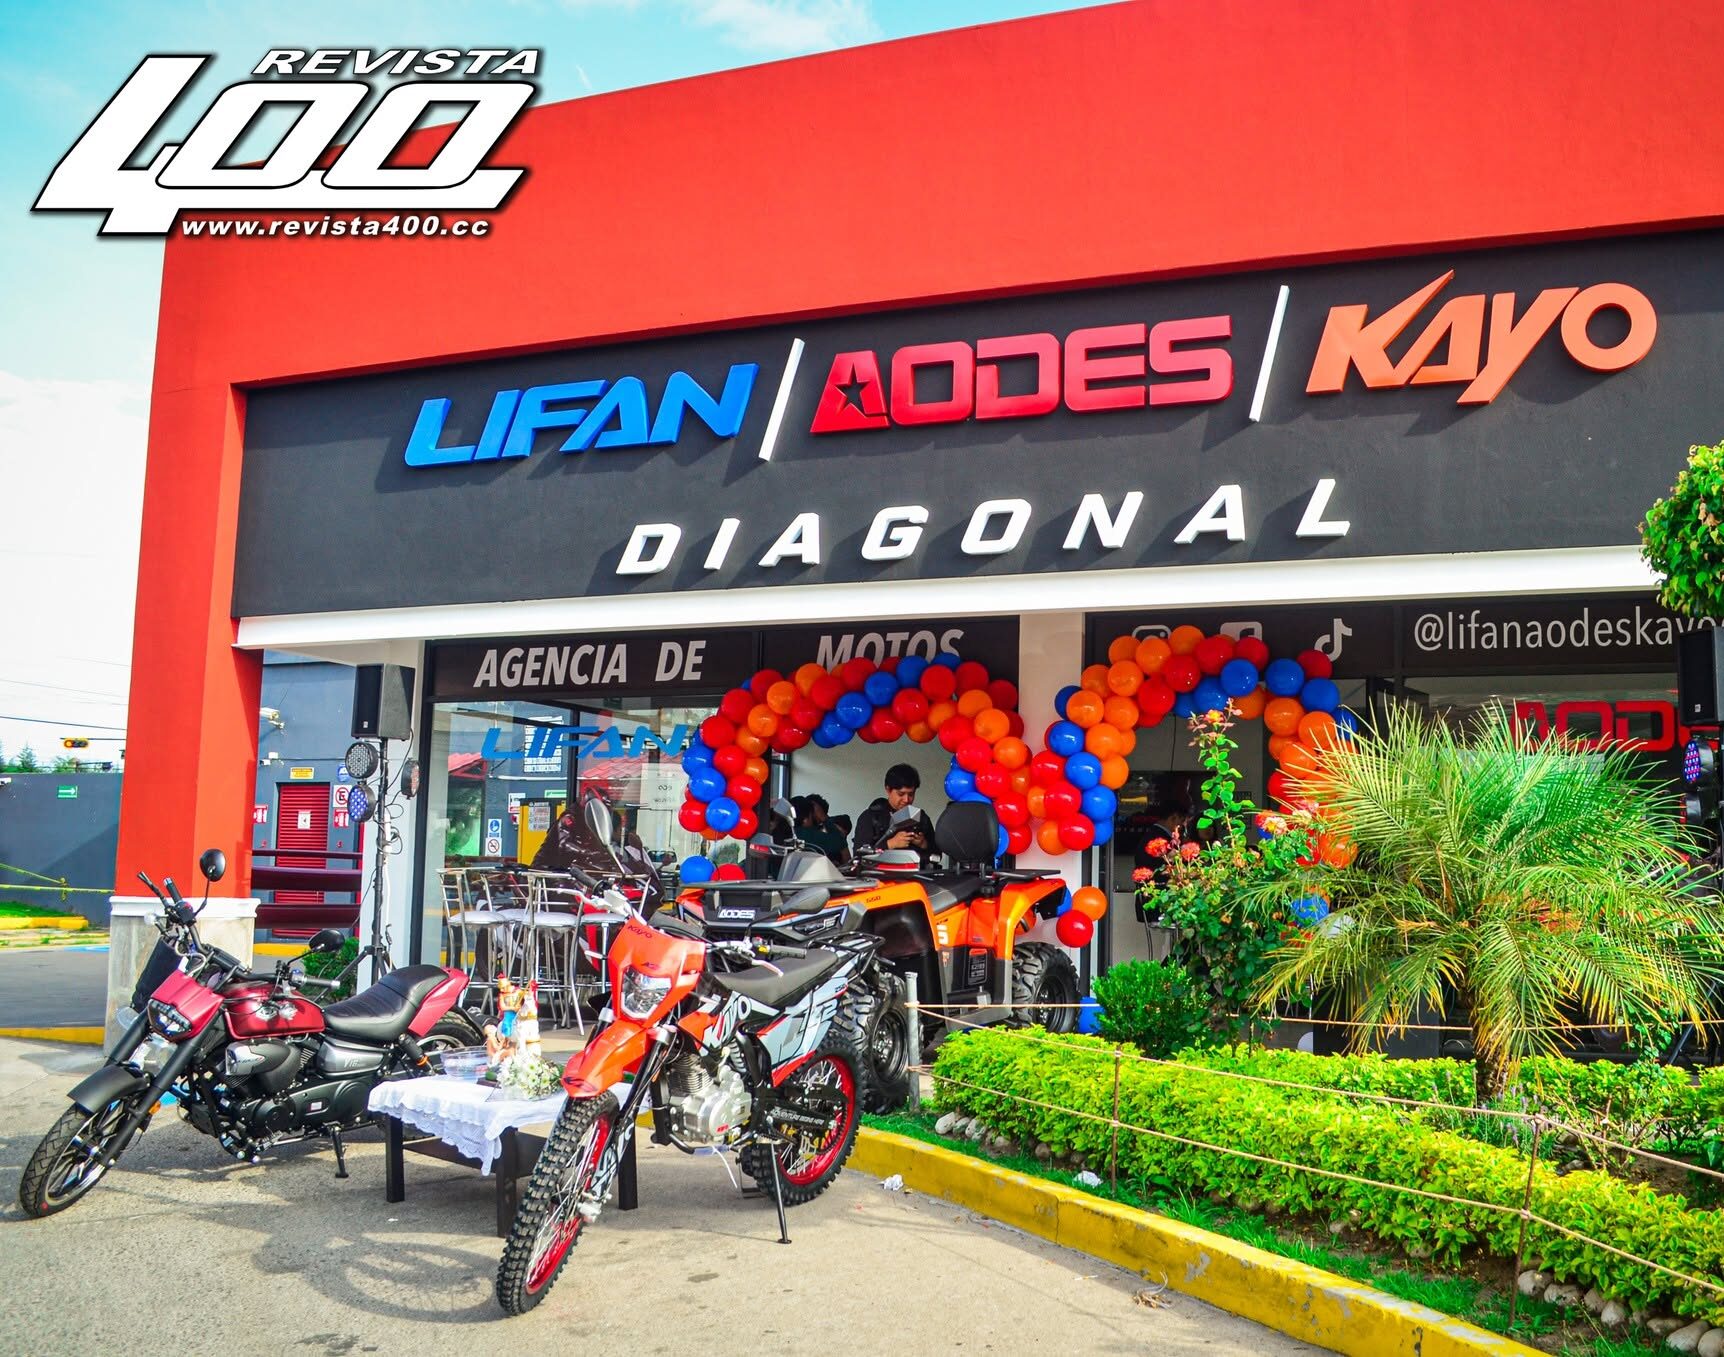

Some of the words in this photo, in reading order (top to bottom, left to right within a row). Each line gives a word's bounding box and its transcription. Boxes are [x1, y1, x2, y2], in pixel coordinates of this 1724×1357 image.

[404, 362, 759, 468] LIFAN
[810, 315, 1234, 434] AODES
[1305, 269, 1657, 406] KAYO
[615, 479, 1351, 576] DIAGONAL
[473, 643, 628, 688] AGENCIA
[655, 640, 707, 682] DE
[816, 629, 964, 674] MOTOS
[480, 724, 690, 760] LIFAN
[718, 908, 756, 919] AODES
